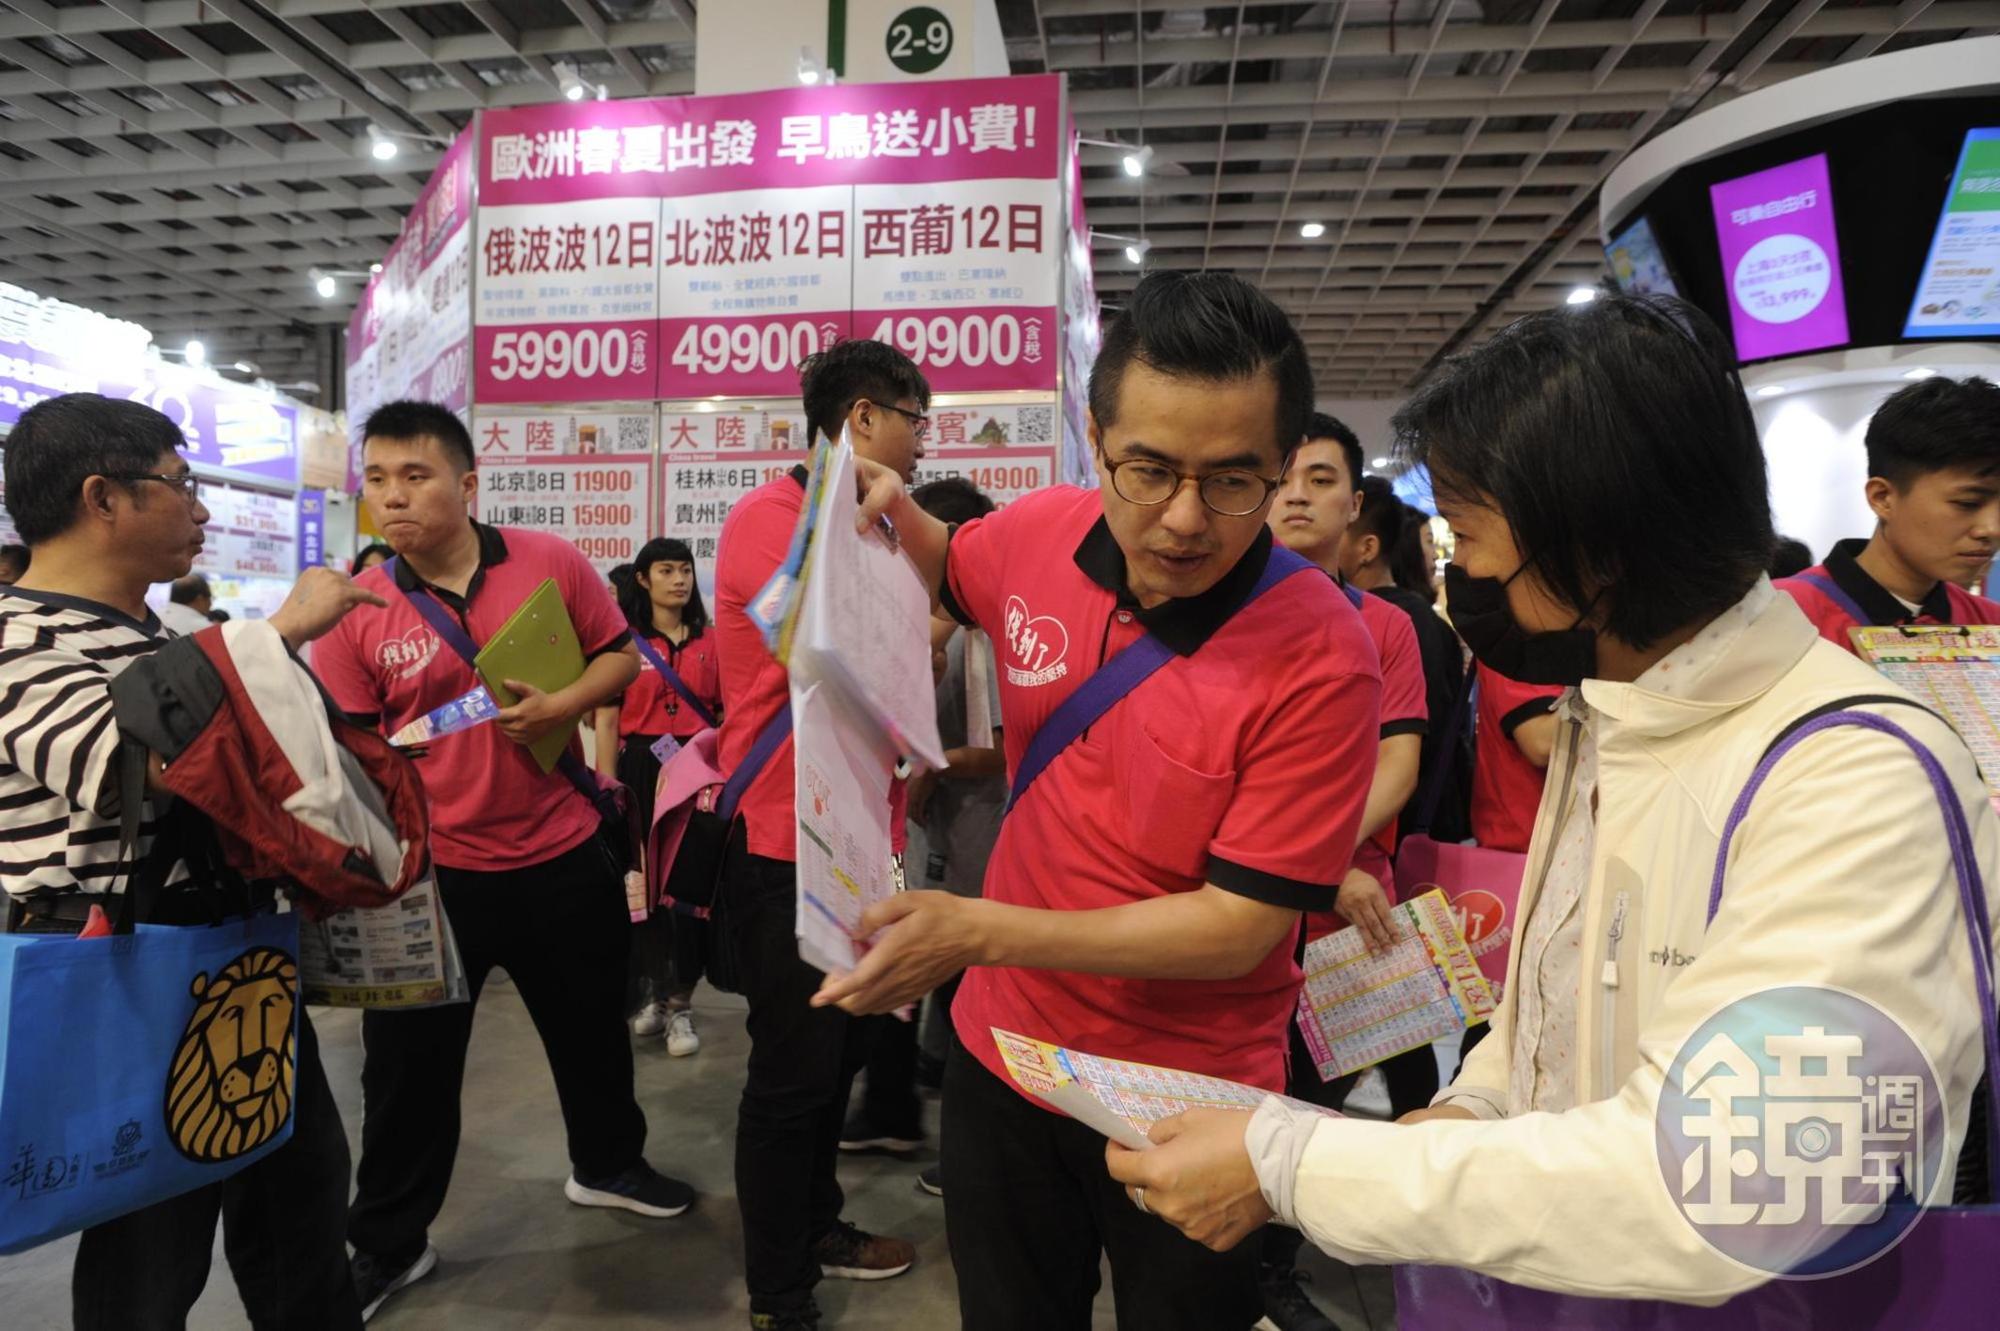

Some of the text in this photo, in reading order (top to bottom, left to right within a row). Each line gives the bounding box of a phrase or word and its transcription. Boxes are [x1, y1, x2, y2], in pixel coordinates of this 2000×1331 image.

[890, 21, 950, 58] 2-9
[490, 102, 1037, 183] 歐洲春夏出發 早鳥送小費!
[484, 221, 654, 277] 俄波波12日
[665, 209, 845, 268] 北波波12日
[862, 203, 1043, 260] 西葡12日
[490, 328, 629, 381] 59900
[671, 320, 819, 374] 49900
[482, 420, 556, 452] 大陸
[669, 416, 746, 449] 大陸
[573, 470, 632, 492] 11900
[969, 467, 1039, 489] 14900
[572, 504, 632, 526] 15900
[1006, 605, 1049, 671] 找到了
